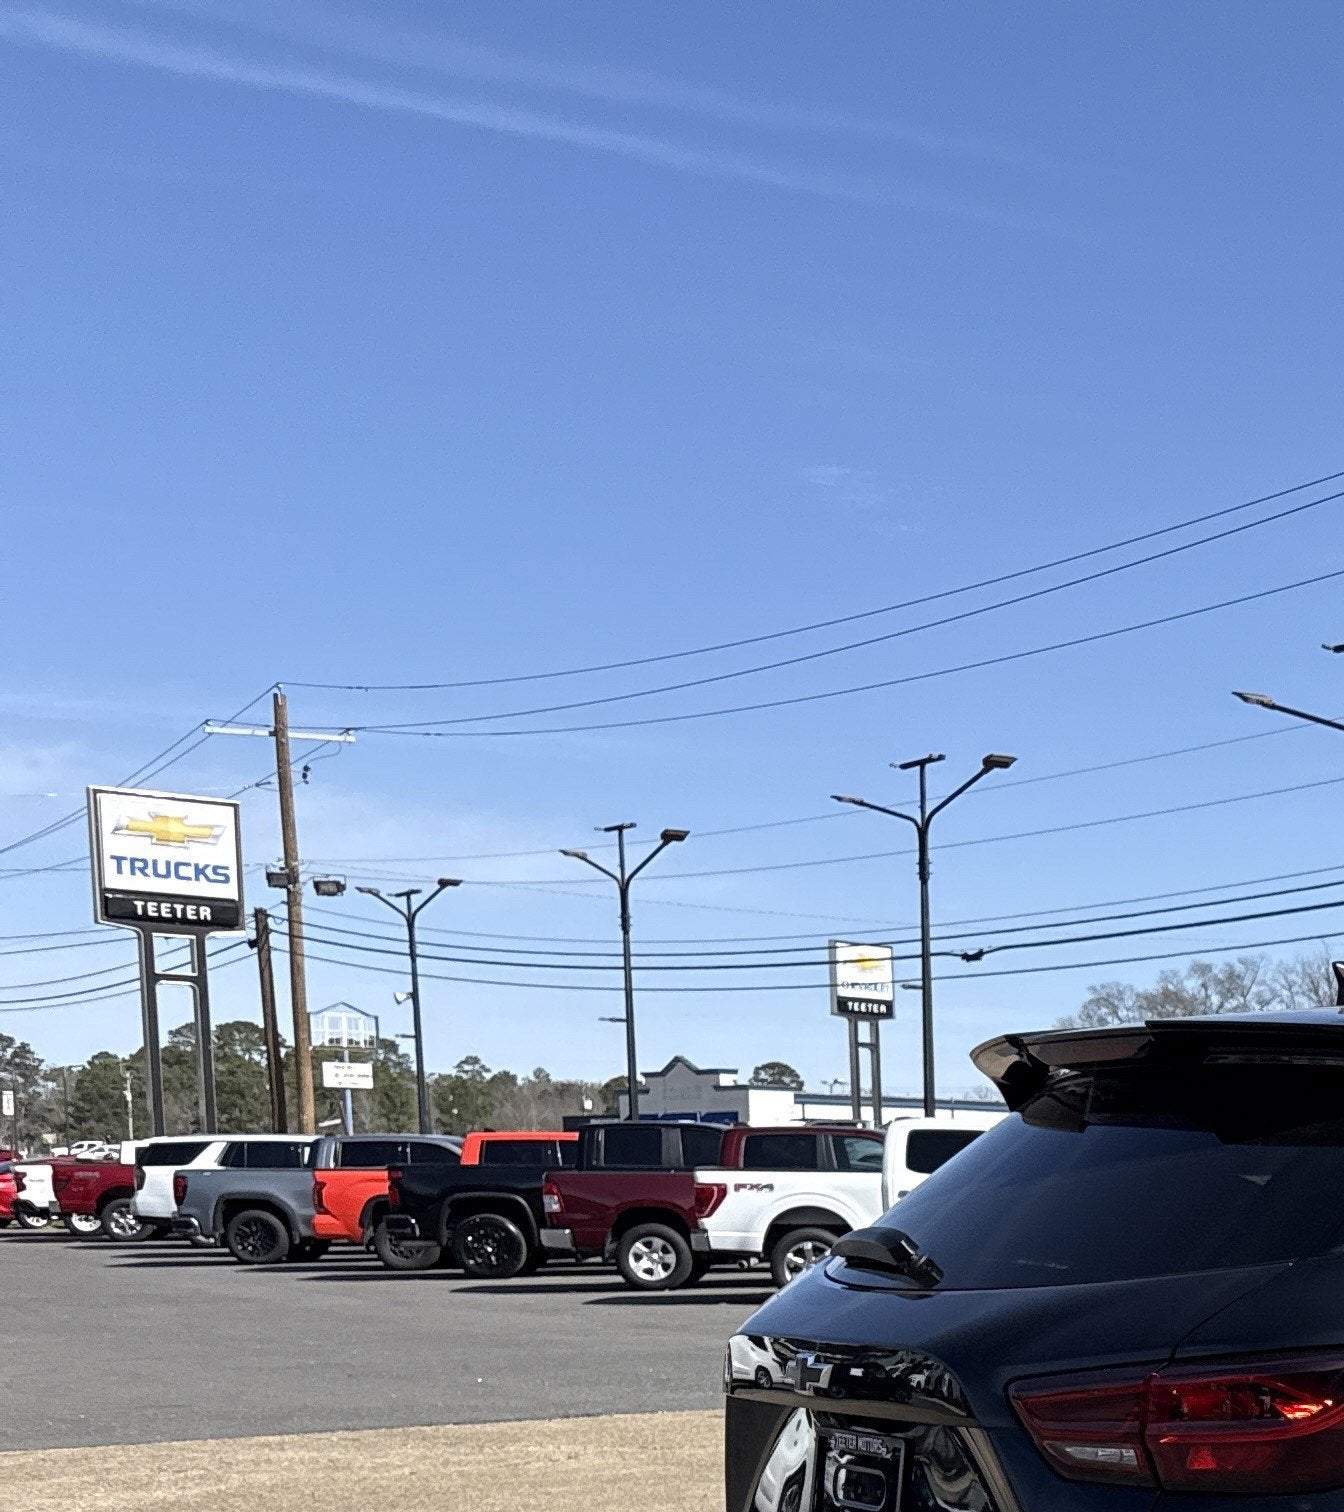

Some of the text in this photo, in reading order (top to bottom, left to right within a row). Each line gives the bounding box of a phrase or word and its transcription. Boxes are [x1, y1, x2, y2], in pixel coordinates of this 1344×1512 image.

[110, 855, 231, 884] TRUCKS
[133, 900, 212, 921] TEETER
[847, 1001, 887, 1014] TEETER
